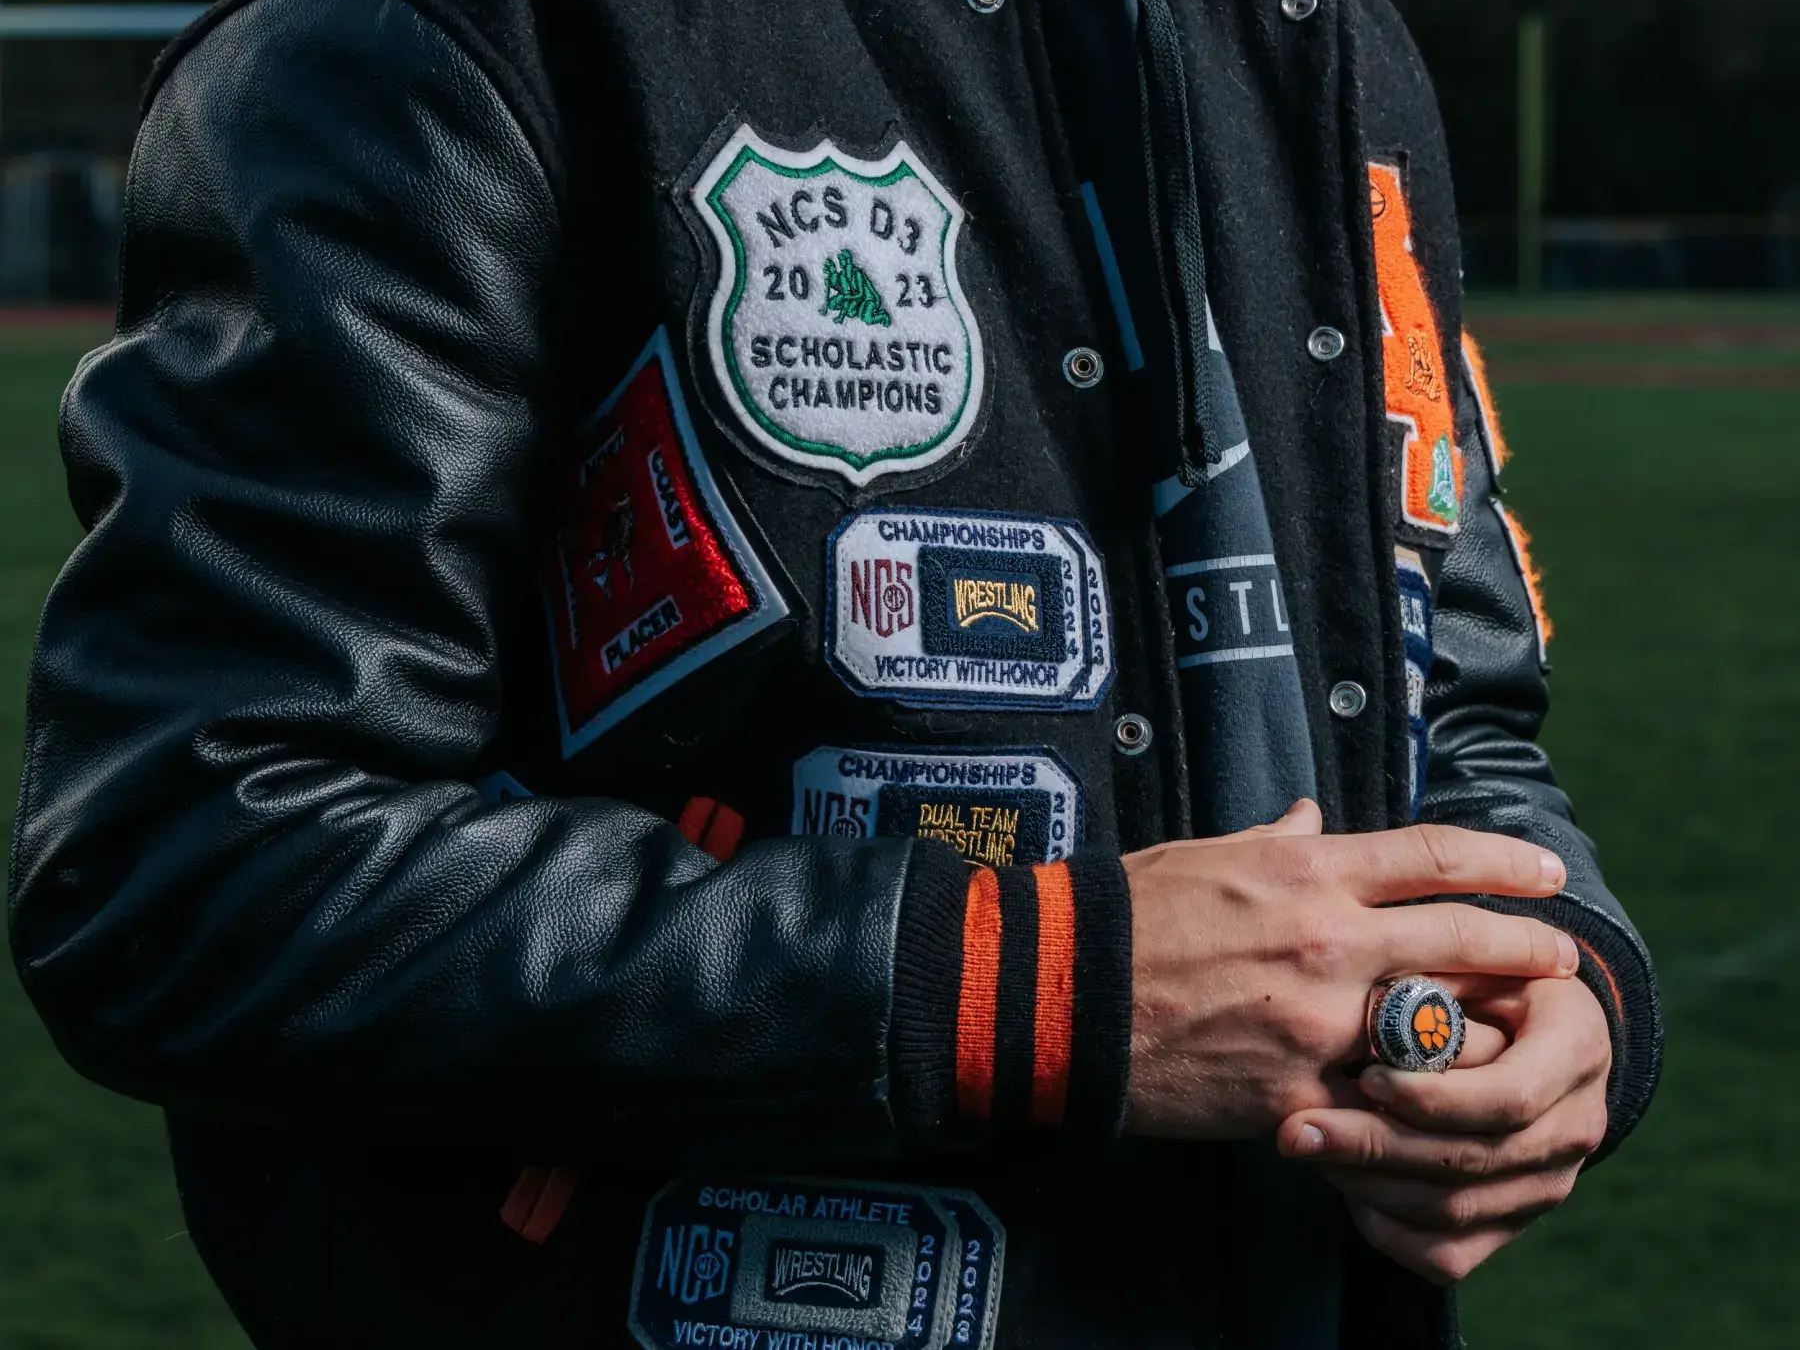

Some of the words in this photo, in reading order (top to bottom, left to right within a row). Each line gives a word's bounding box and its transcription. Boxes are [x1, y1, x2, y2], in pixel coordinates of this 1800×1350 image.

[756, 186, 848, 248] NCS
[870, 199, 920, 256] D3
[763, 265, 809, 301] 20
[895, 274, 934, 308] 23
[751, 336, 951, 374] SCHOLASTIC
[768, 376, 942, 414] CHAMPIONS
[879, 519, 1045, 550] CHAMPIONSHIPS
[954, 579, 1037, 629] WRESTLING
[1062, 559, 1079, 660] 2024
[1087, 567, 1105, 666] 2023
[605, 601, 681, 671] PLACER
[875, 655, 949, 681] VICTORY
[956, 660, 998, 683] WITH
[999, 662, 1058, 687] HONOR
[838, 754, 1036, 787] CHAMPIONSHIPS
[920, 804, 964, 829] DUAL
[970, 807, 1018, 833] TEAM
[698, 1187, 806, 1217] SCHOLAR
[813, 1196, 912, 1225] ATHLETE
[657, 1225, 734, 1305] NCS
[773, 1248, 873, 1301] WRESTLING
[908, 1235, 934, 1337] 2024
[956, 1240, 980, 1343] 2023
[673, 1319, 760, 1349] VICTORY
